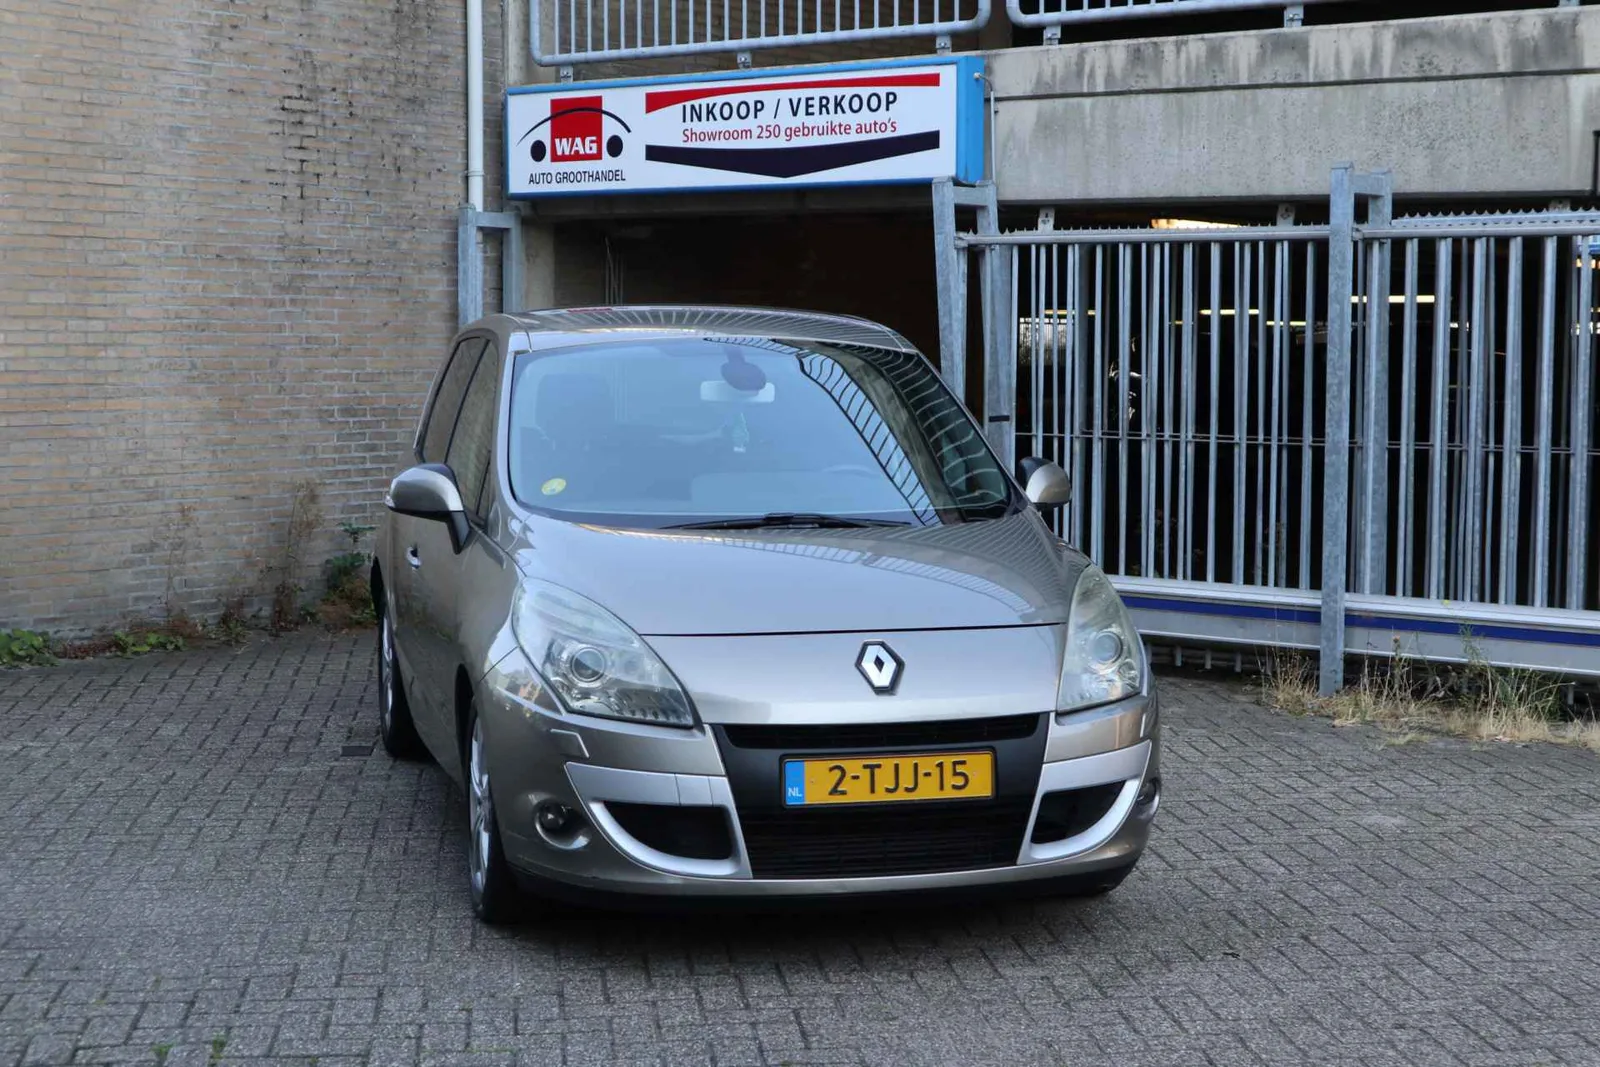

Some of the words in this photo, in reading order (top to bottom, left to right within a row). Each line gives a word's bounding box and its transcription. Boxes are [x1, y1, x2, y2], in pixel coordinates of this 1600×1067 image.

[682, 100, 765, 123] INKOOP
[773, 98, 781, 119] /
[788, 91, 898, 117] VERKOOP
[682, 127, 753, 143] Showroom
[756, 124, 781, 140] 250
[784, 120, 852, 142] gebruikte
[855, 117, 897, 135] auto's
[554, 136, 598, 156] WAG
[528, 172, 553, 185] AUTO
[555, 169, 626, 184] GROOTHANDEL
[827, 760, 970, 796] 2-TJJ-15
[788, 787, 802, 798] NL
